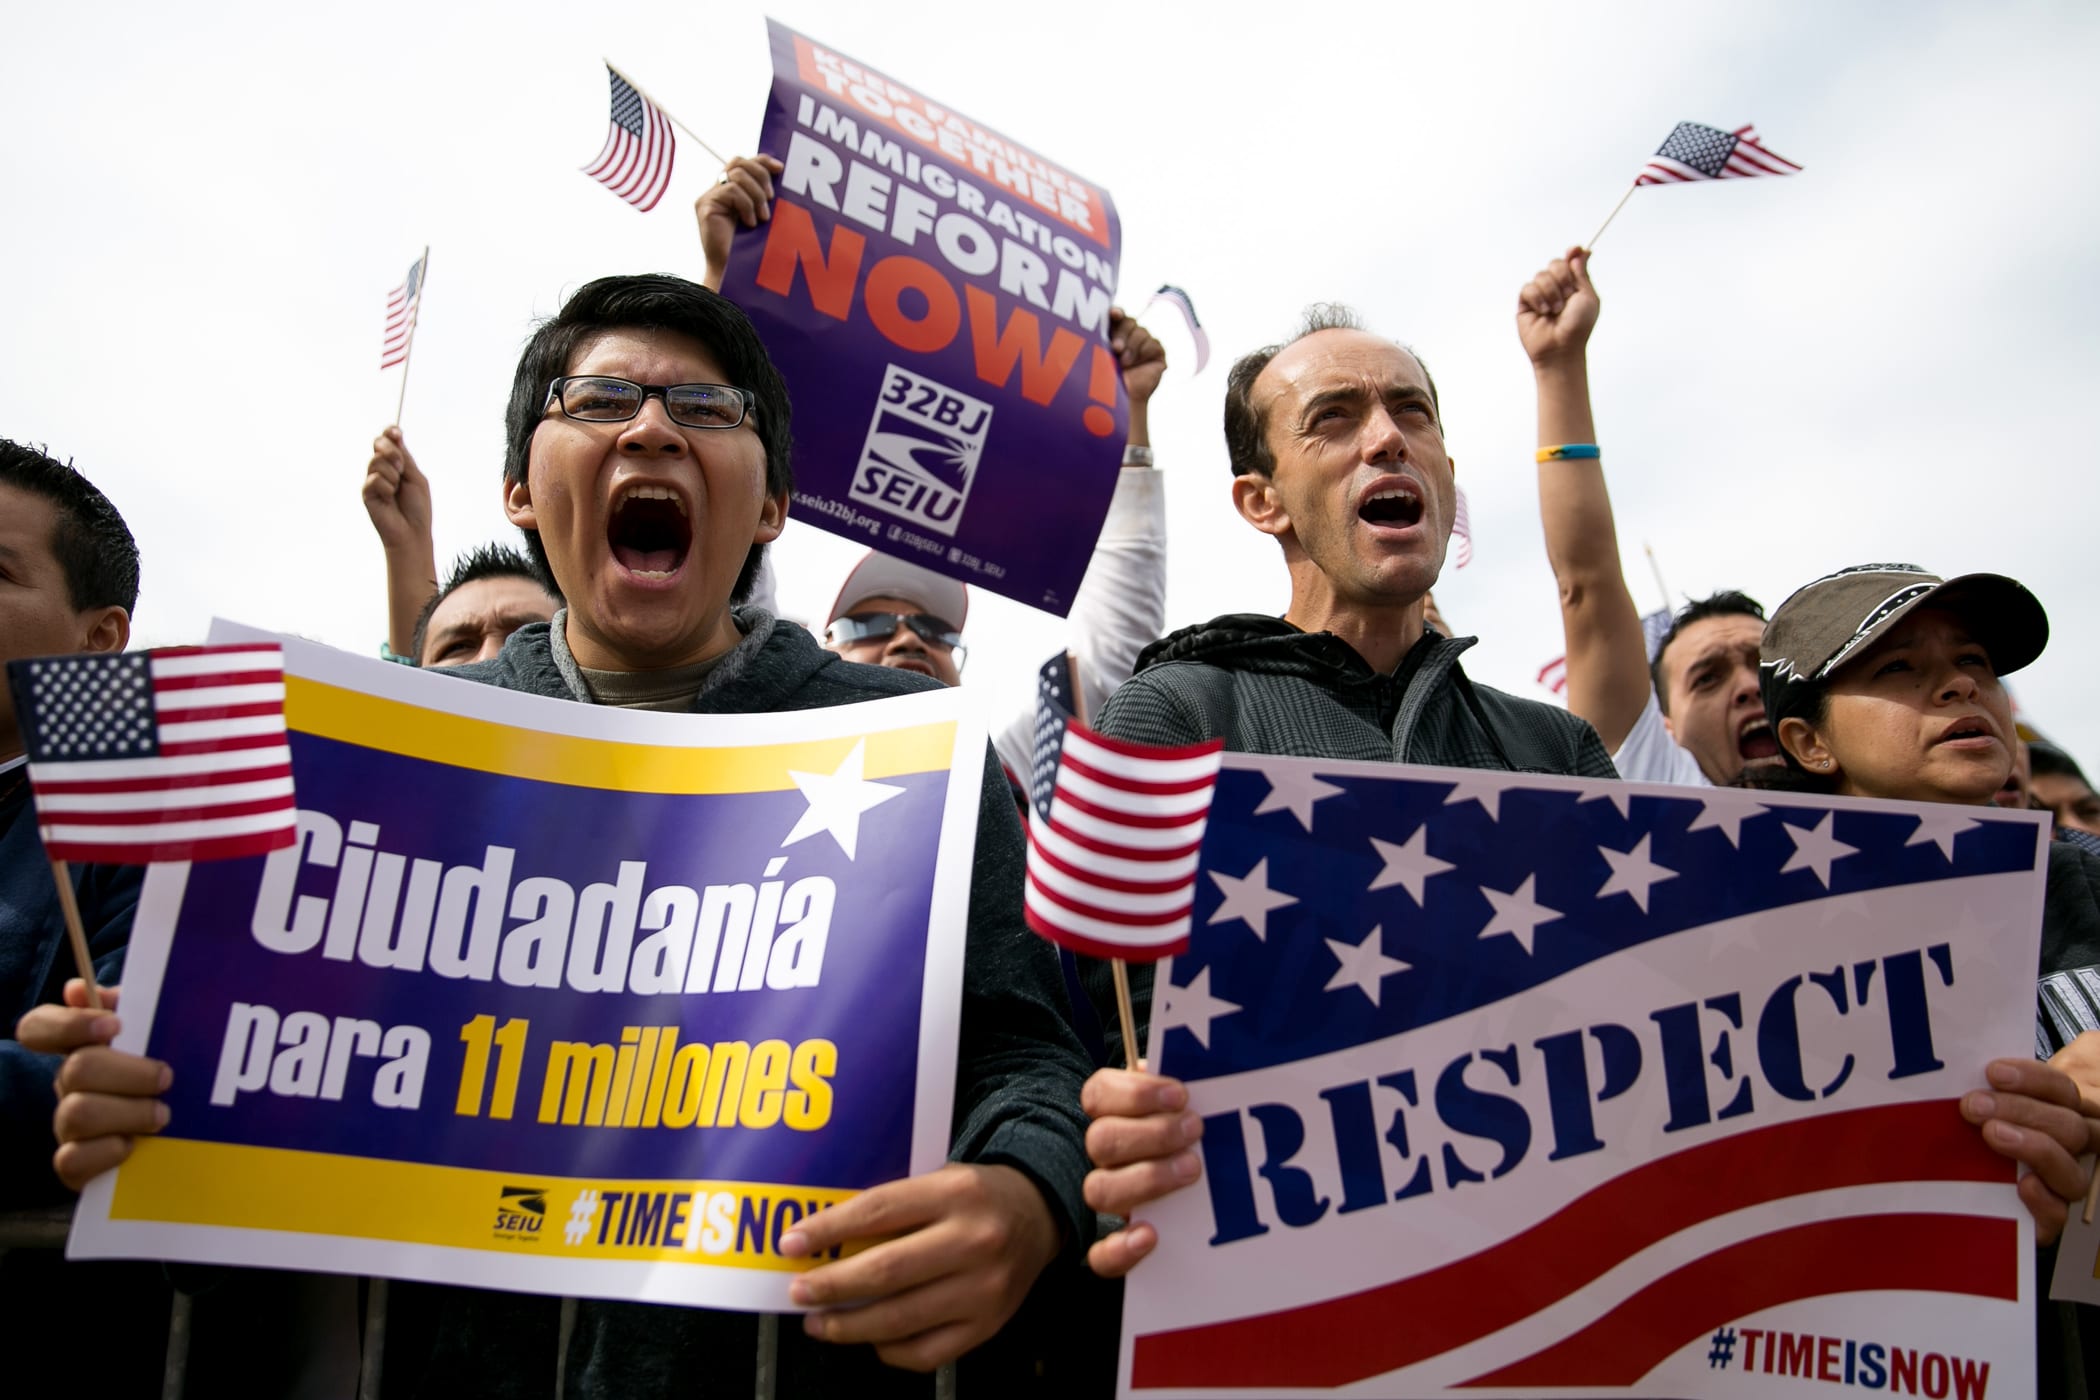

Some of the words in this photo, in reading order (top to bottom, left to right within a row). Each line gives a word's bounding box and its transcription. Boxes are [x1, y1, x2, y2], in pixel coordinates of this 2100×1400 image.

[797, 93, 1114, 294] IMMIGRATION
[812, 46, 912, 104] KEEP
[924, 102, 1089, 202] FAMILIES
[816, 64, 1094, 232] TOGETHER
[780, 131, 1110, 343] REFORM
[756, 198, 1118, 437] NOW!
[882, 373, 989, 435] 32BJ
[855, 466, 961, 522] SEIU
[250, 809, 837, 994] Ciudadanía
[210, 1002, 431, 1109] para
[455, 1014, 529, 1120] 11
[537, 1025, 838, 1131] millones
[1202, 942, 1955, 1247] RESPECT
[493, 1213, 544, 1232] SEIU
[563, 1188, 843, 1260] #TIMEISNO
[1707, 1326, 1990, 1400] #TIMEISNOW
